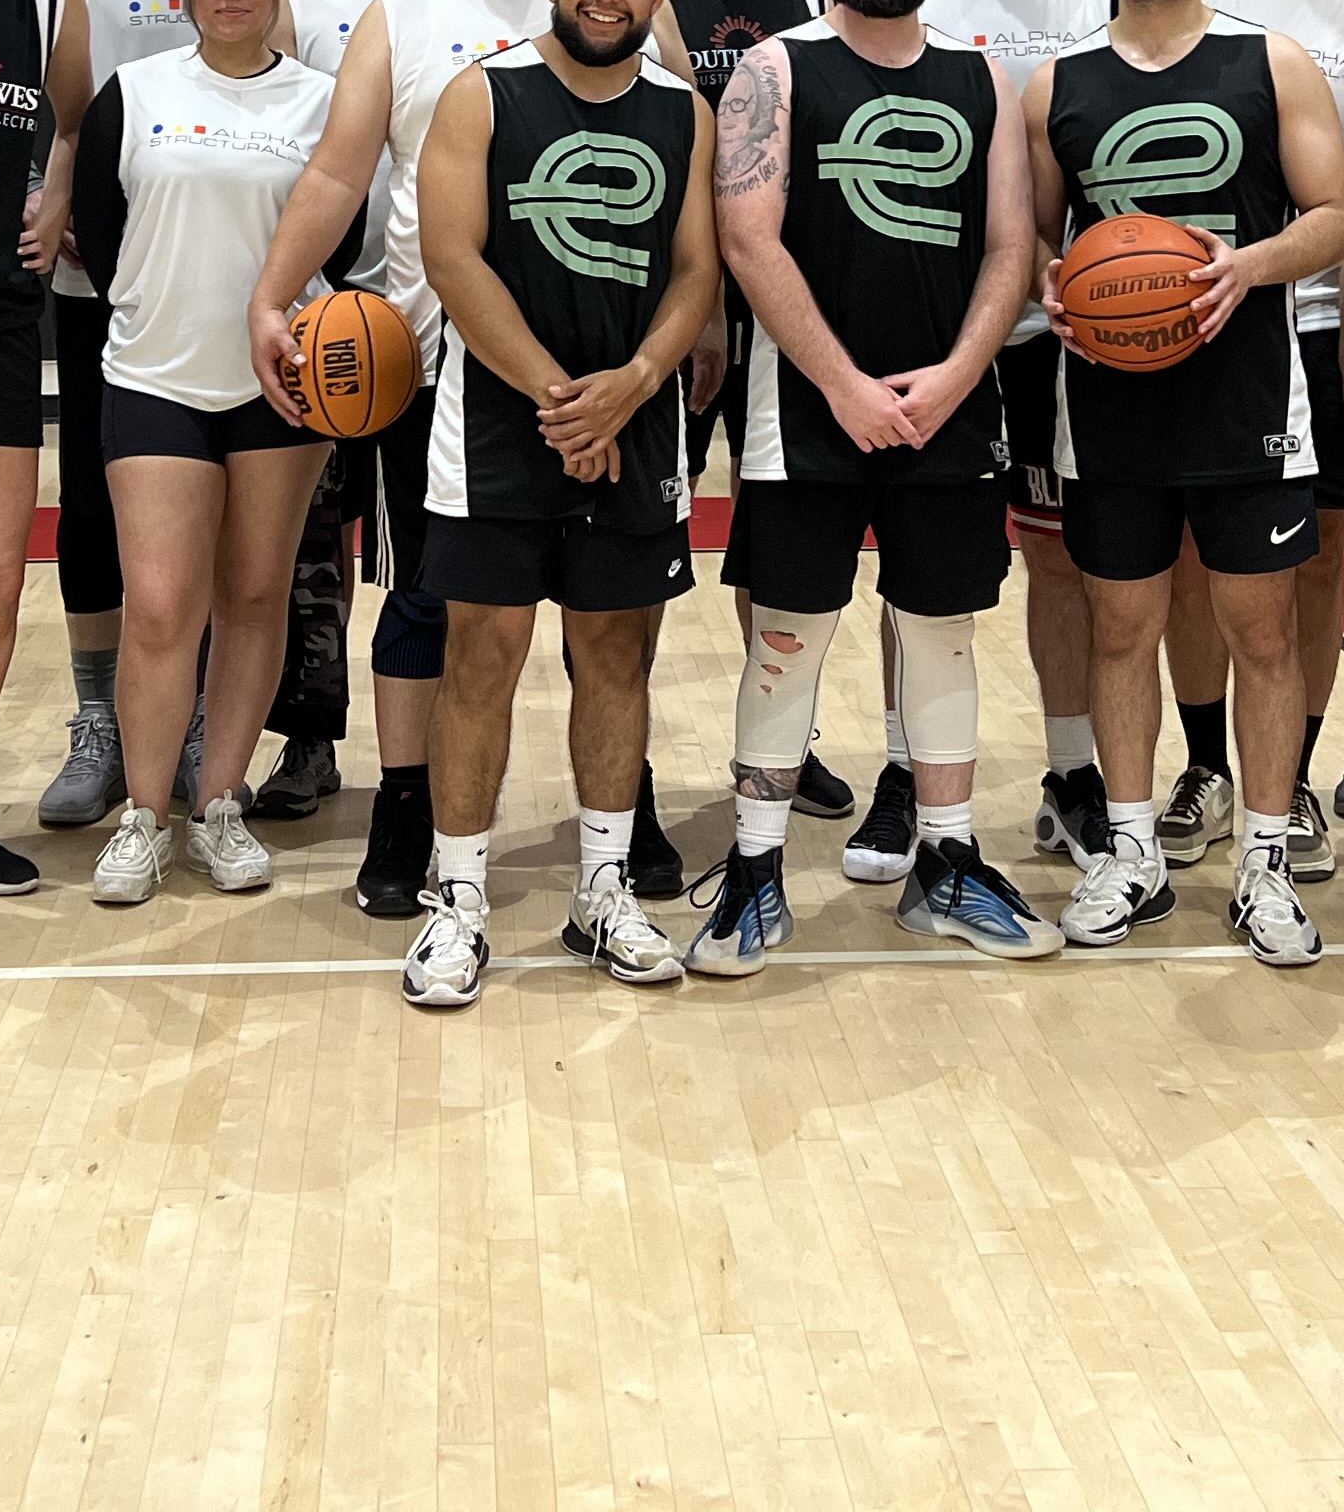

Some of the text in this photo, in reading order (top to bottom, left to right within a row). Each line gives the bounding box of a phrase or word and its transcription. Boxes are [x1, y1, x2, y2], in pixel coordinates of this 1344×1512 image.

[993, 30, 1077, 45] ALPHA
[149, 134, 287, 160] STRUCTURAL
[212, 128, 301, 153] ALPHA
[1089, 273, 1190, 302] EVOLUTION
[1089, 313, 1199, 353] Wilson
[322, 338, 358, 379] NBA
